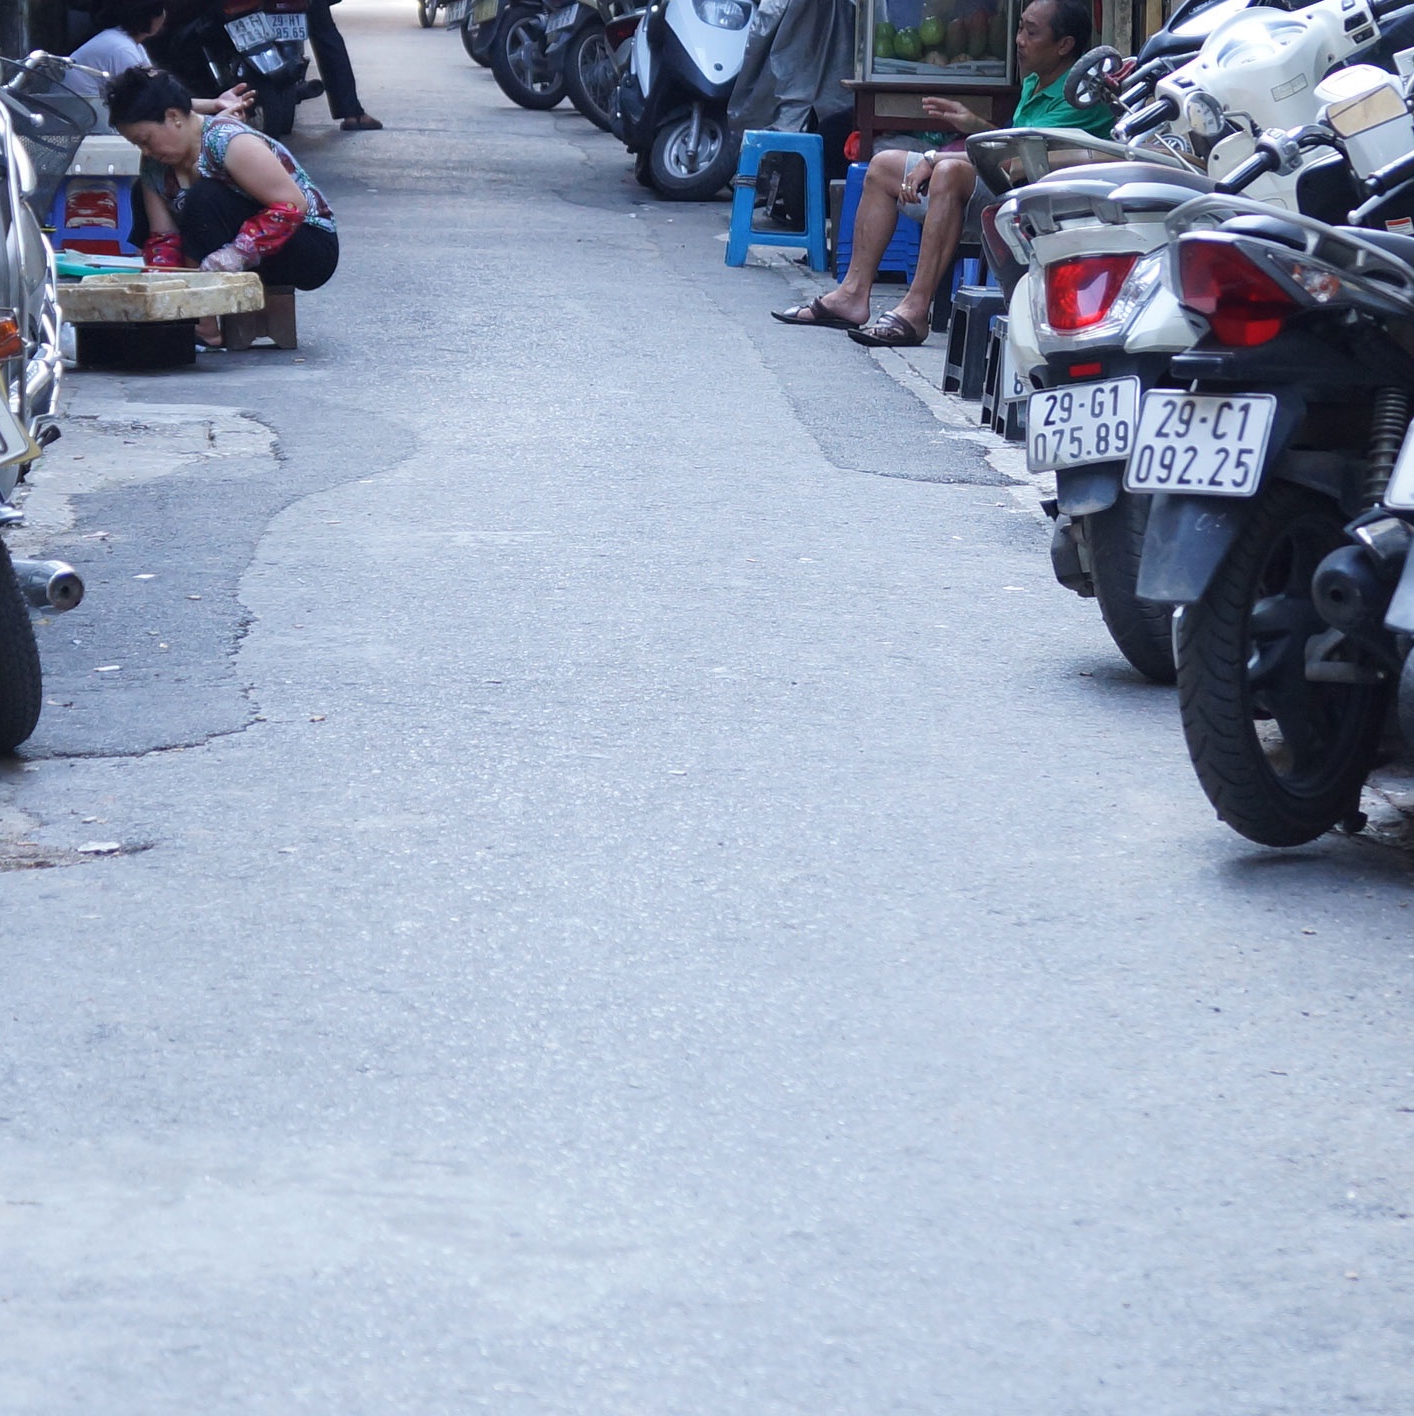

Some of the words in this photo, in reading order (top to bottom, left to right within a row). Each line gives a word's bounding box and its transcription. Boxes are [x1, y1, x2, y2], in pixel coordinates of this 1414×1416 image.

[1043, 385, 1120, 426] 29-G1
[1154, 400, 1251, 442] 29-C1
[1033, 419, 1130, 466] 075.89
[1134, 444, 1255, 488] 092.25
